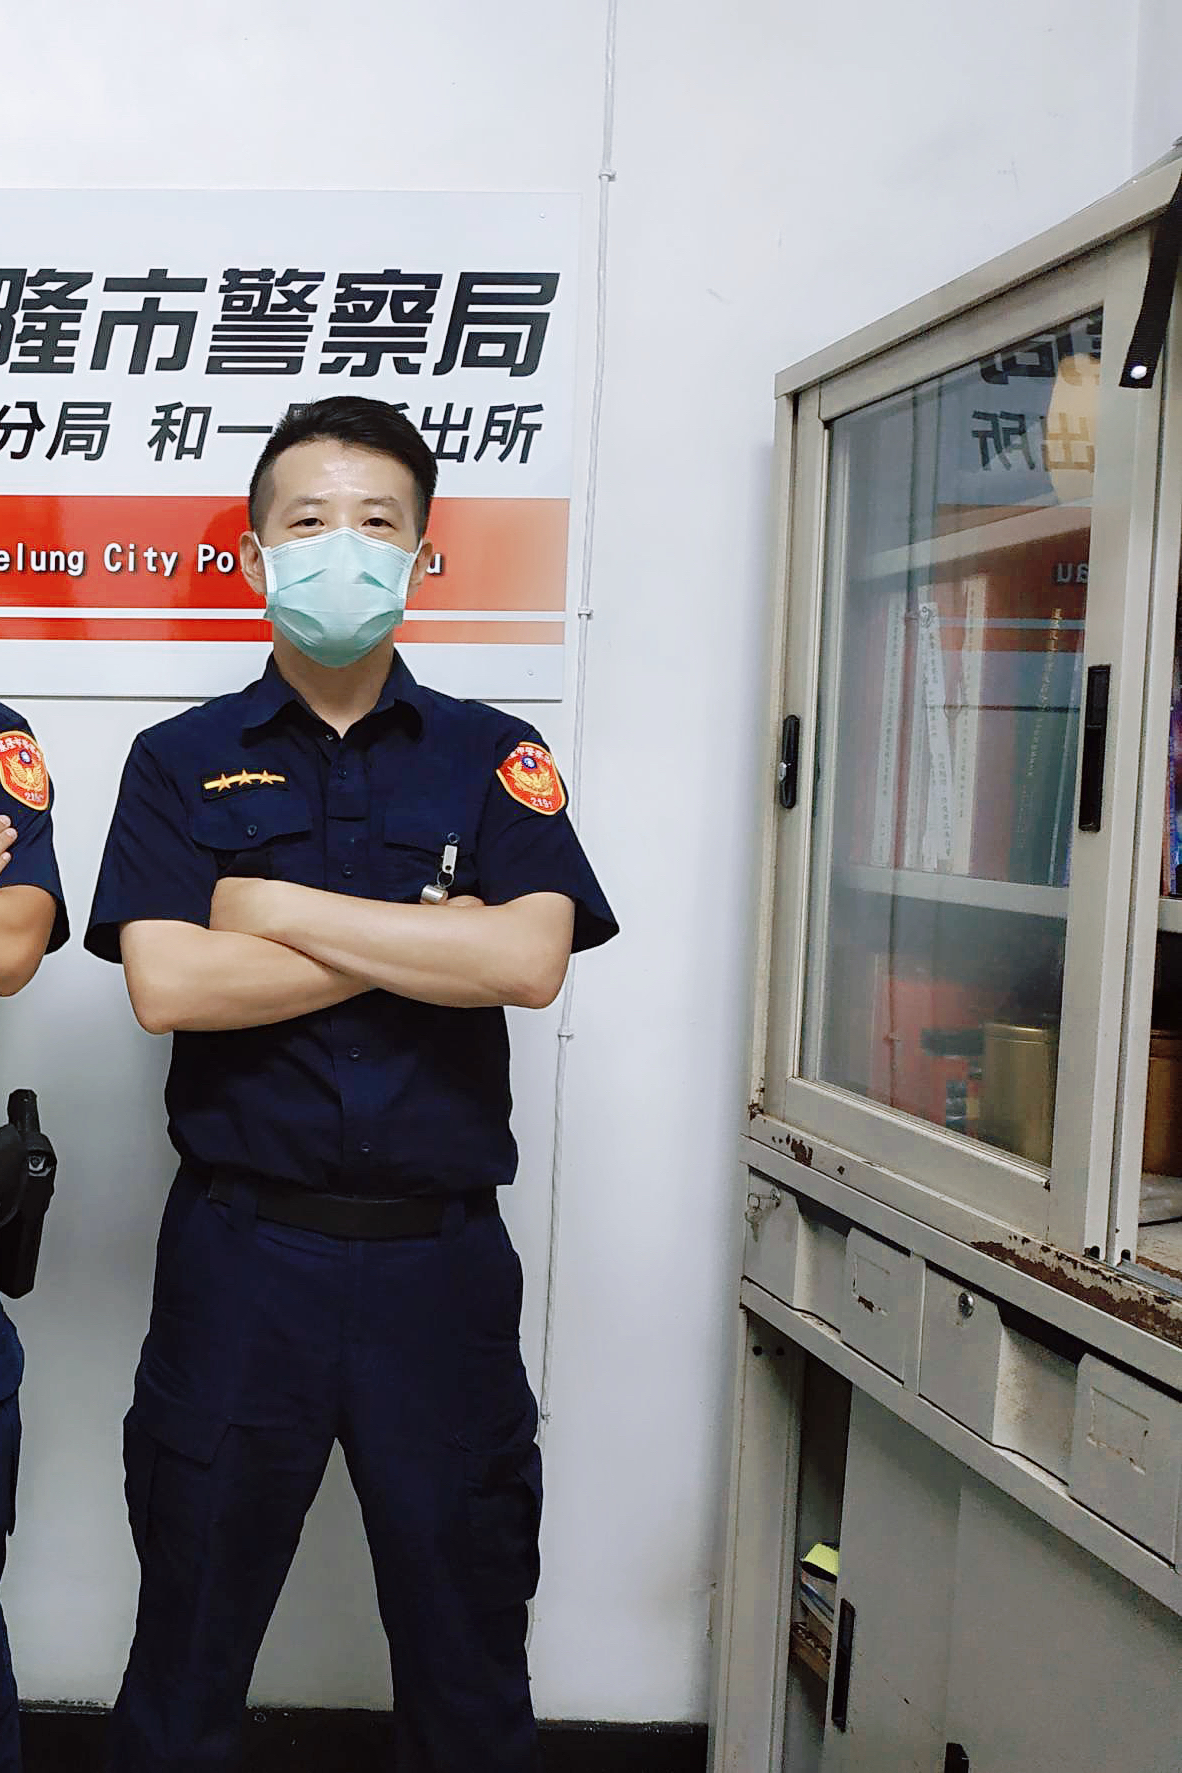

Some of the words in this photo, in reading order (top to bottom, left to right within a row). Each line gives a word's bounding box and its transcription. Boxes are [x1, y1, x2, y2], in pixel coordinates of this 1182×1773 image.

[147, 401, 544, 464] 和一出所
[103, 541, 179, 577] City
